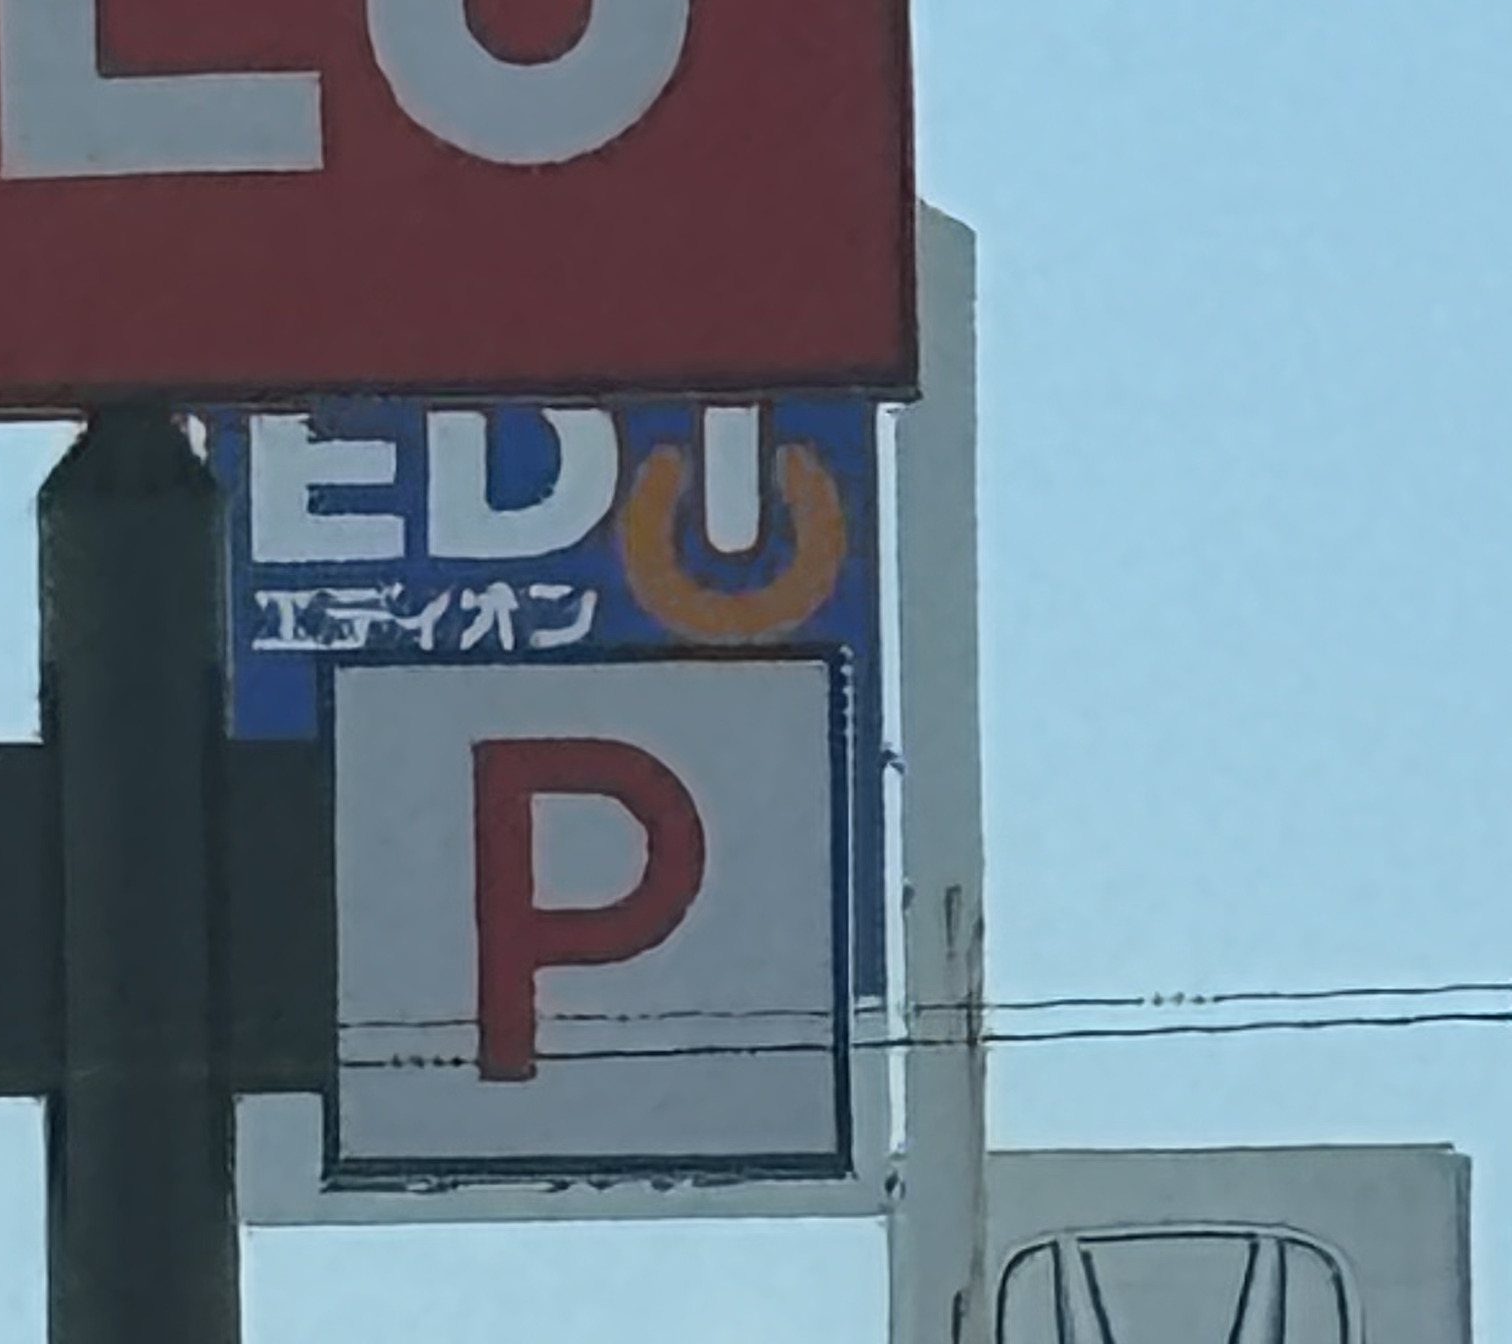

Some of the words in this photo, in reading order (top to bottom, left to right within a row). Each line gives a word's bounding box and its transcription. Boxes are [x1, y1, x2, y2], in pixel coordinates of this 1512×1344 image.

[251, 581, 598, 652] エディオン
[471, 736, 706, 1082] P
